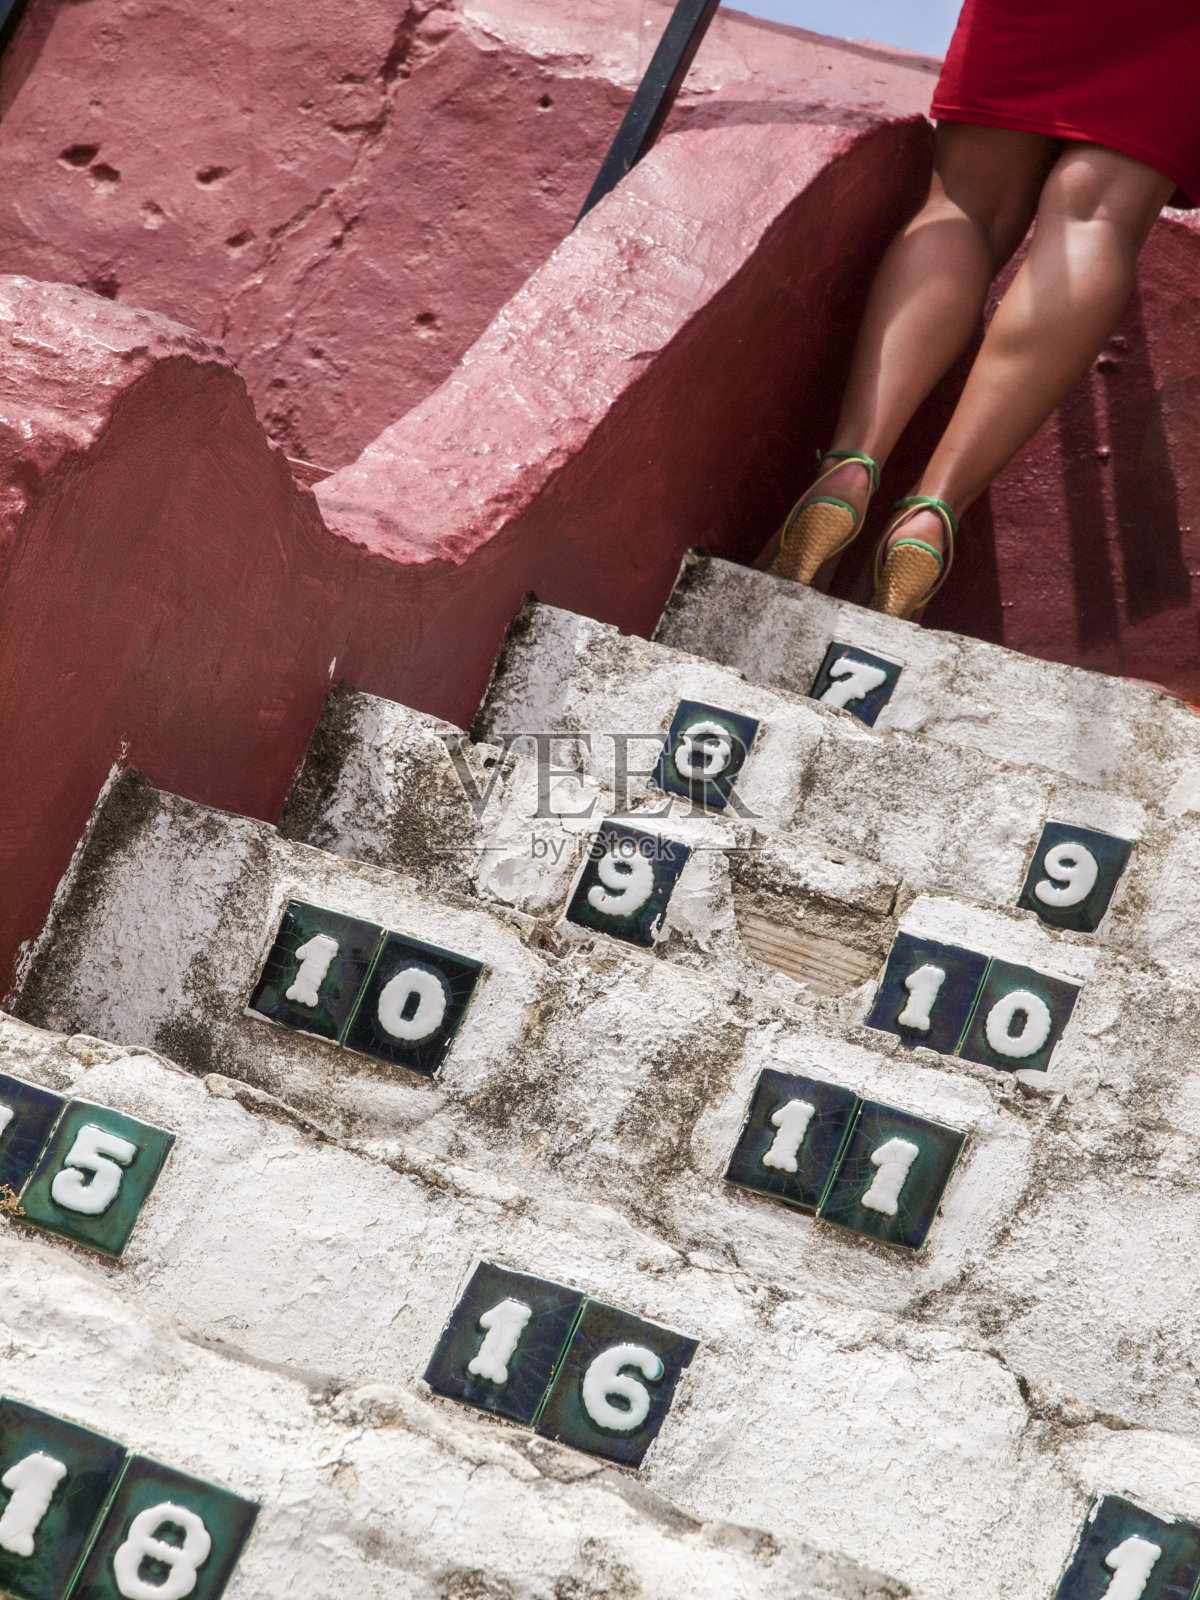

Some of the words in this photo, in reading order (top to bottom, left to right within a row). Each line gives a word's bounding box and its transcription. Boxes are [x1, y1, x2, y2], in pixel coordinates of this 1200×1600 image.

[820, 657, 887, 708] 7
[675, 720, 732, 780] 8
[587, 845, 654, 916] 9
[1035, 841, 1098, 907] 9
[286, 934, 446, 1041] 10
[899, 964, 1052, 1058] 10
[762, 1099, 919, 1216] 11
[468, 1297, 665, 1431] 16
[0, 1451, 211, 1600] 18
